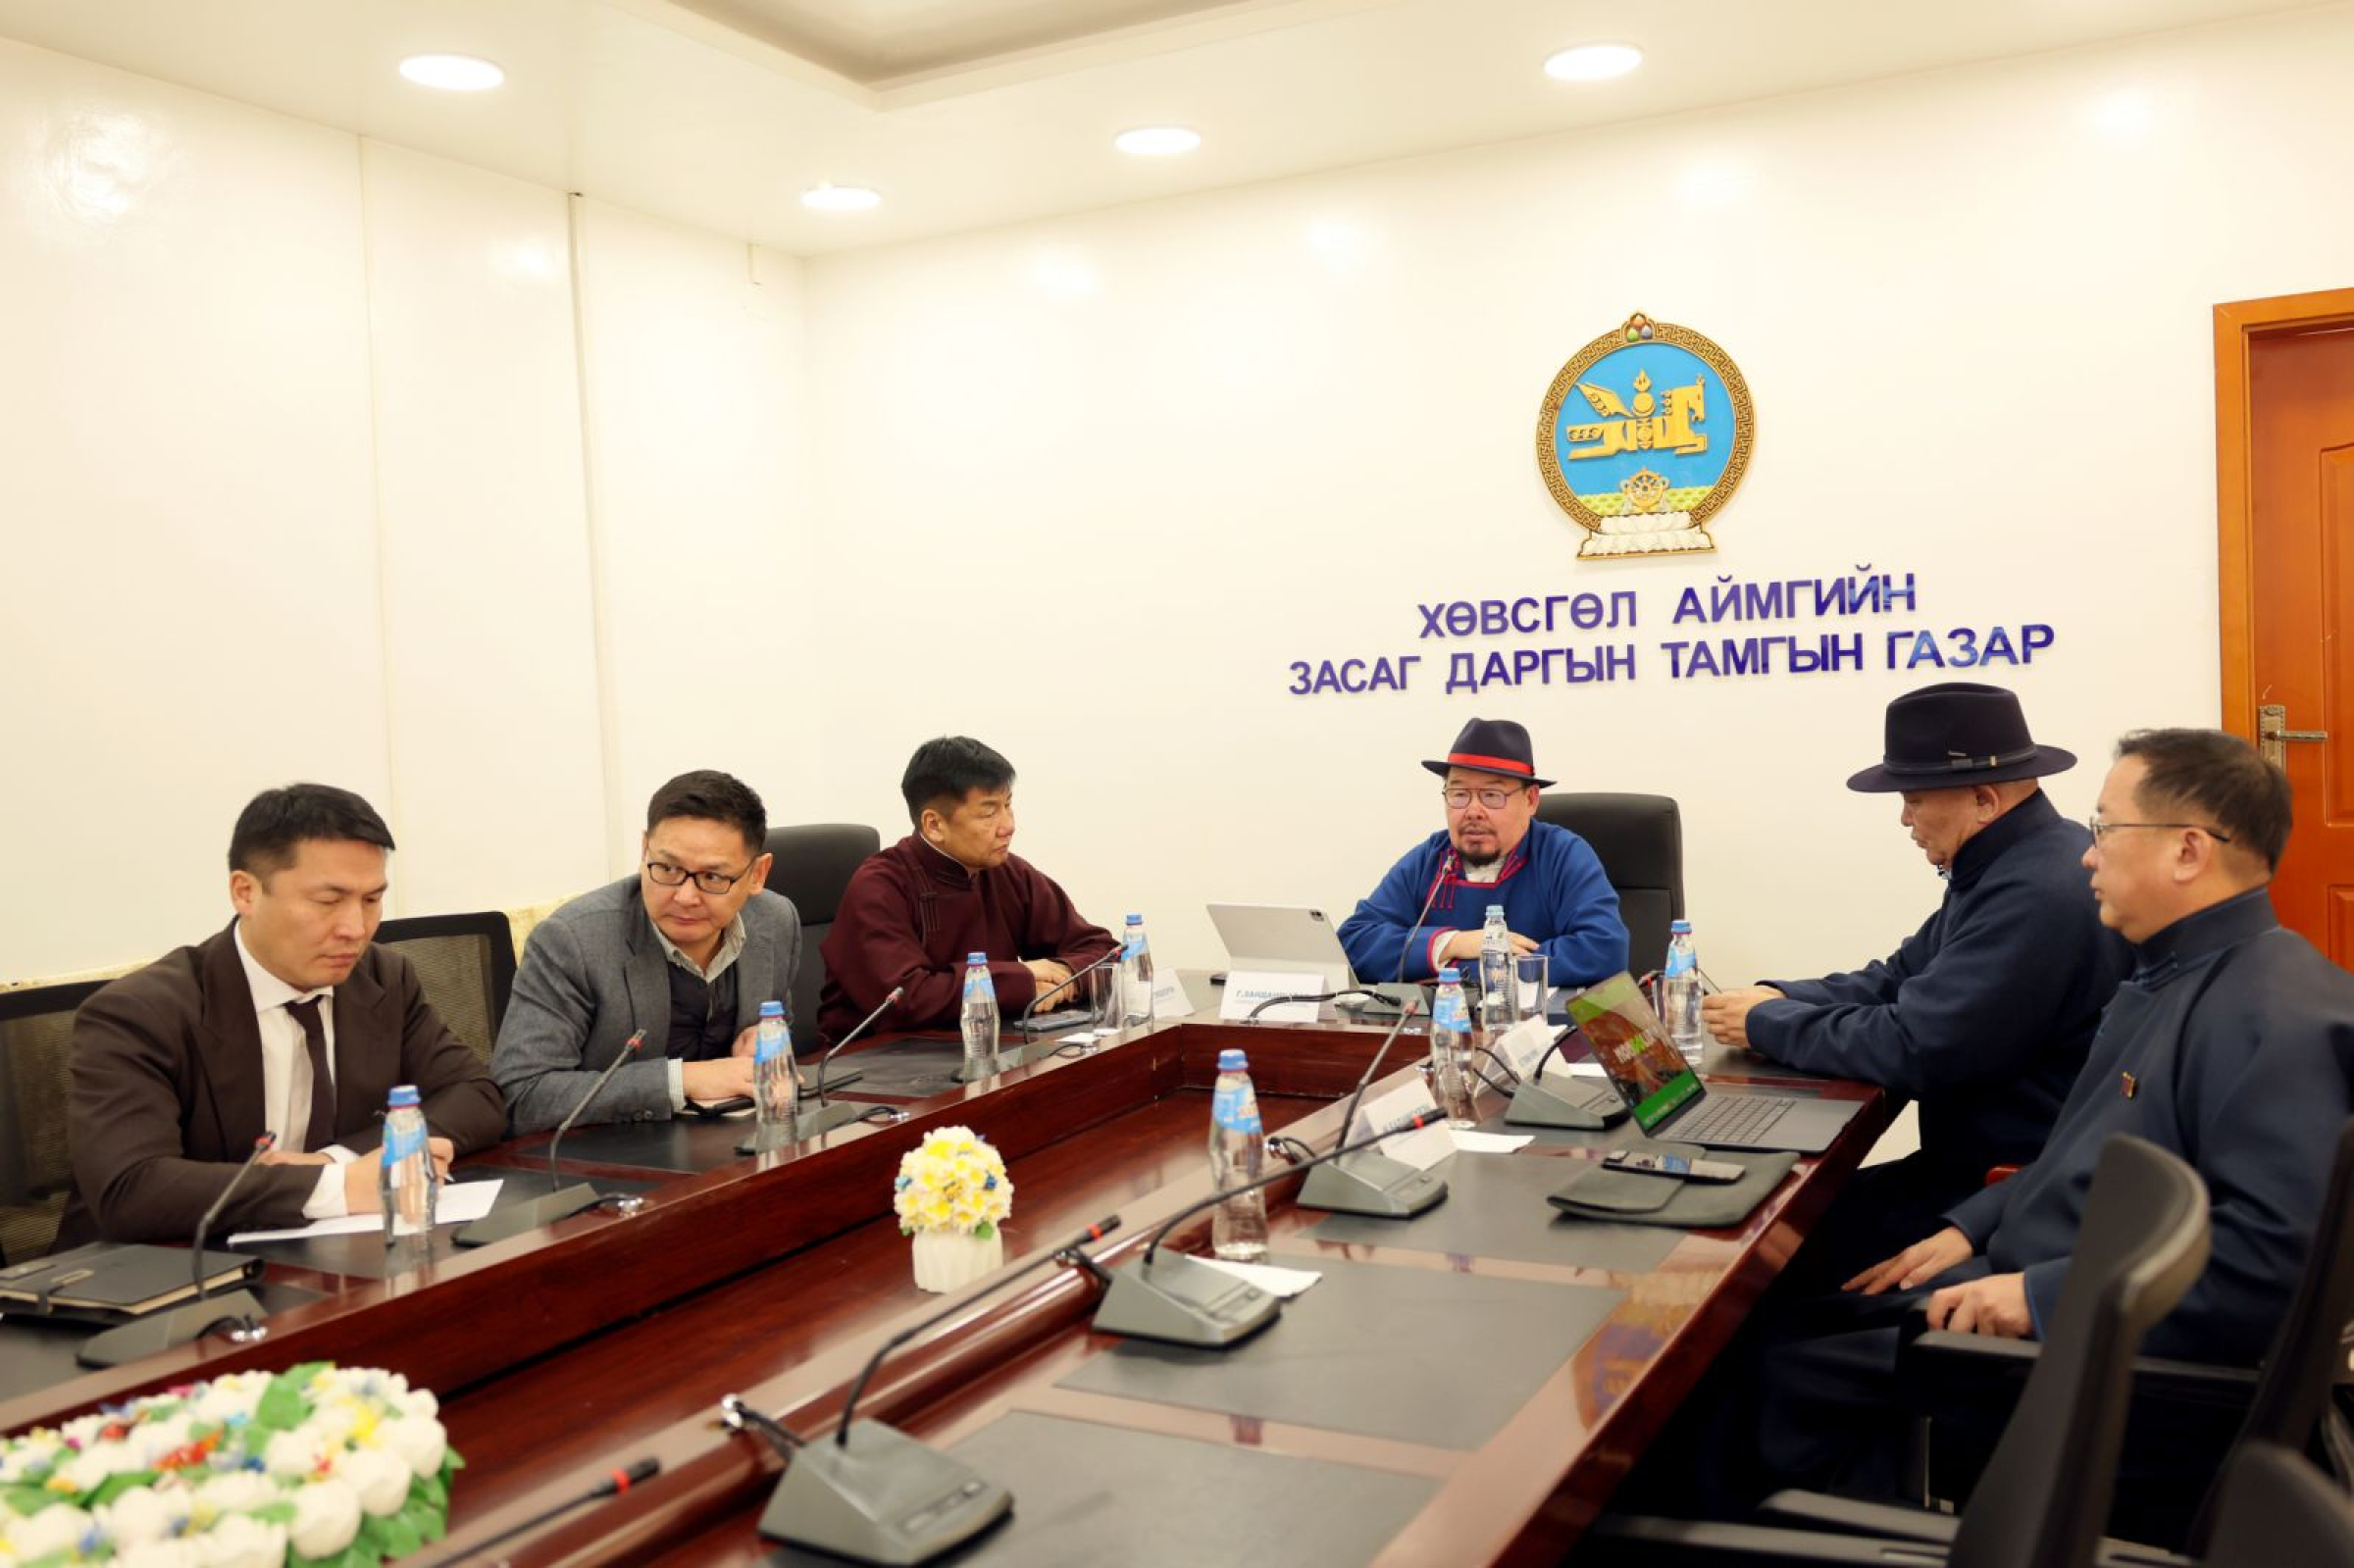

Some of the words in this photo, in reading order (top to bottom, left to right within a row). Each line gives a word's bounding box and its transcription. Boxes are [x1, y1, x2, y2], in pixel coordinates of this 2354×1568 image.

[1417, 590, 1637, 638] ХӨВСГӨЛ
[1672, 563, 1918, 625] АЙМГИЙН
[1289, 655, 1421, 695] ЗАСАГ
[1446, 643, 1636, 694] ДАРГЫН
[1662, 632, 1864, 679] ТАМГЫН
[1886, 624, 2056, 672] ГАЗАР
